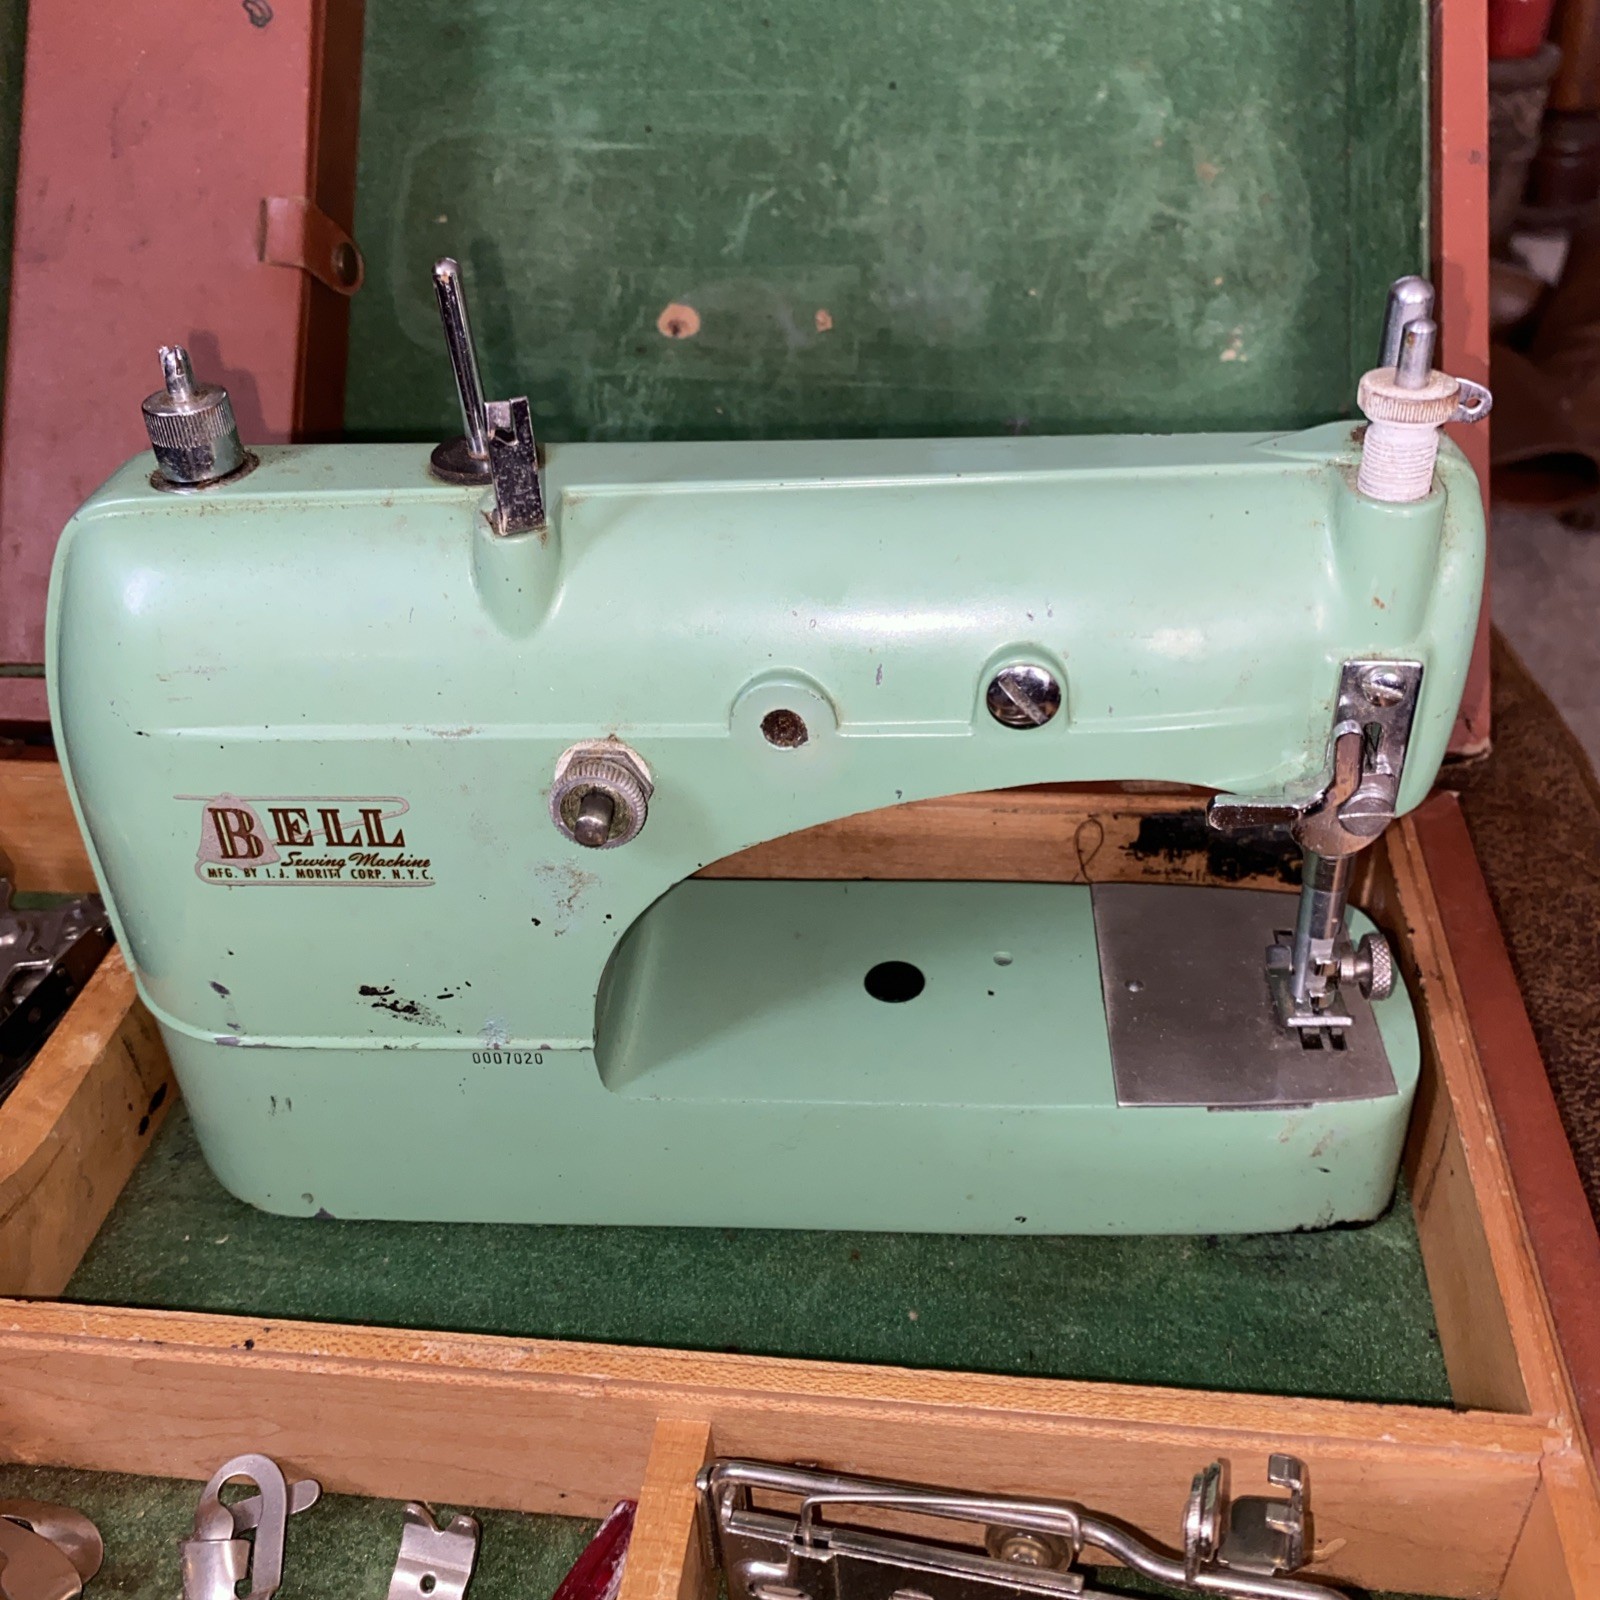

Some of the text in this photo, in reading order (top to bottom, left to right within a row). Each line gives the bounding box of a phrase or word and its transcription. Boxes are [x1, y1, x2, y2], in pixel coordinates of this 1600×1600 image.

[207, 807, 406, 860] BELL
[281, 851, 431, 869] Sewing Machine
[207, 868, 238, 879] MFG.
[243, 867, 258, 878] BY
[350, 868, 386, 880] CORP.
[472, 1051, 543, 1065] 0007020
